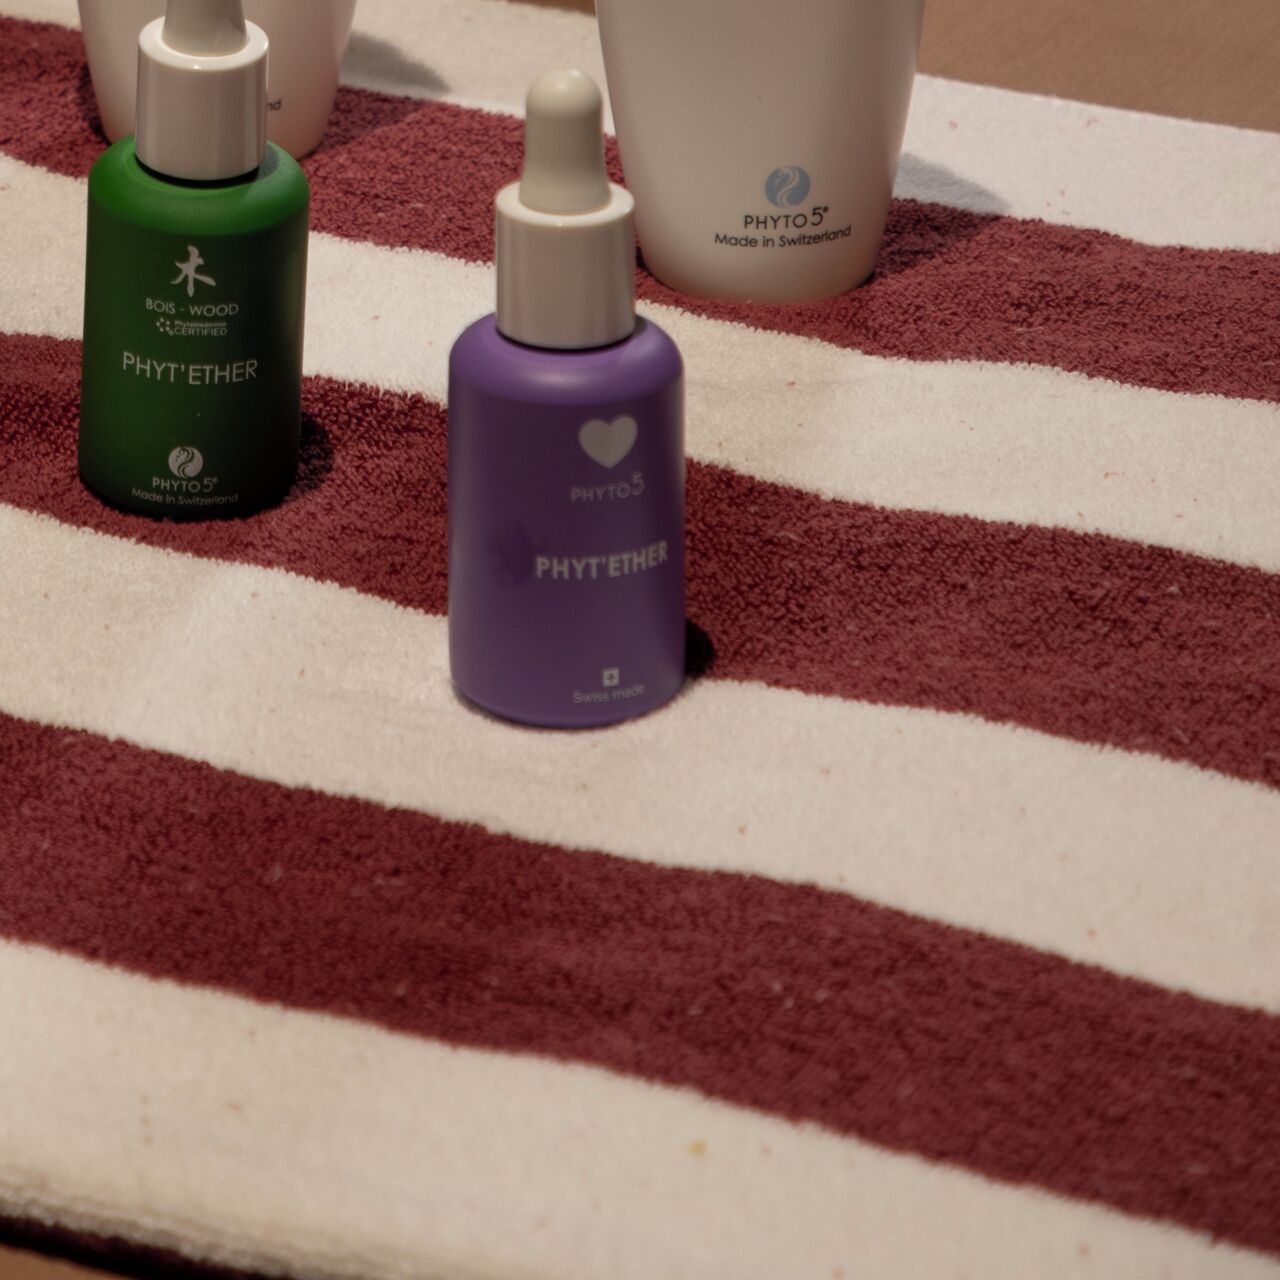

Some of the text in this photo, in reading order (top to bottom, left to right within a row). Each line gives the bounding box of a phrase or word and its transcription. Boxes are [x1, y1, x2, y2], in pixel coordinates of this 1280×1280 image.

[714, 224, 852, 248] Made in Switzerland
[145, 297, 176, 315] BOIS
[188, 303, 239, 318] WOOD
[174, 326, 228, 336] CERTIFIED
[122, 351, 258, 385] PHYT'ETHER
[131, 487, 240, 506] Made in Switzerland
[535, 541, 668, 580] PHYT'ETHER
[573, 684, 646, 704] Swiss made
